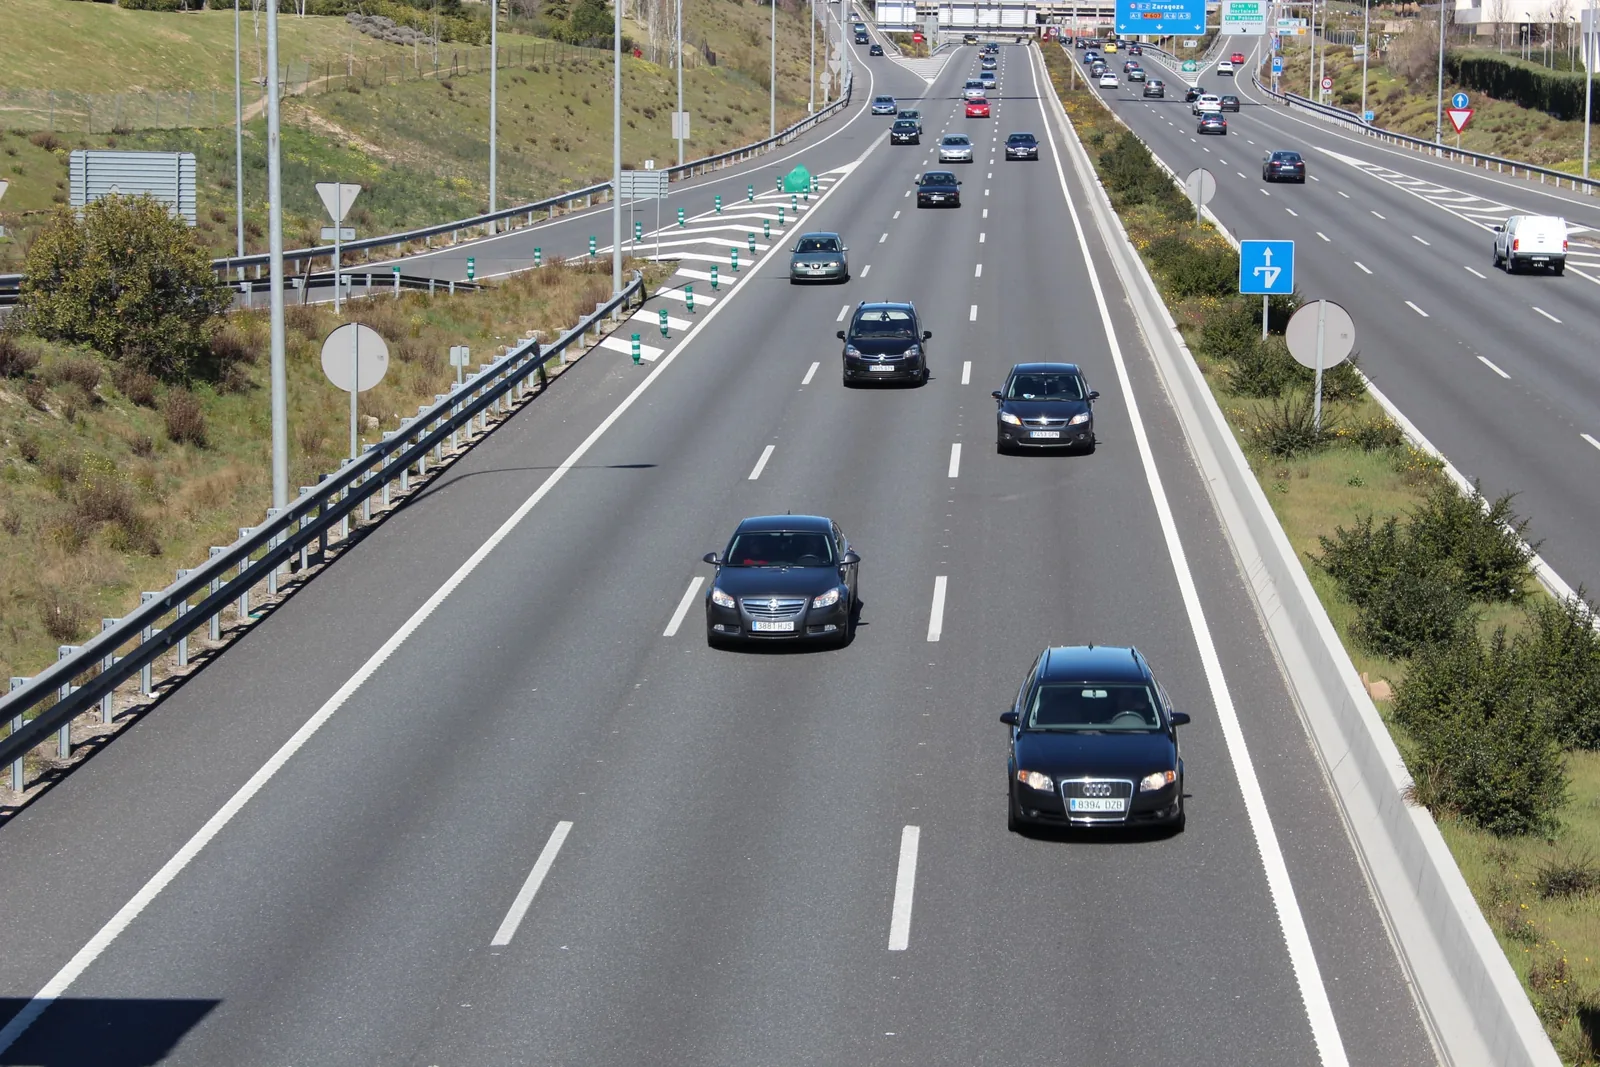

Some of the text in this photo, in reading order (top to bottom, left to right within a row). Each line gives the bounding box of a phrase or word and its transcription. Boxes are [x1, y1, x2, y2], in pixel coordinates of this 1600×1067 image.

[1152, 3, 1184, 11] Zaragoza
[1078, 800, 1122, 810] 8394 DZB
